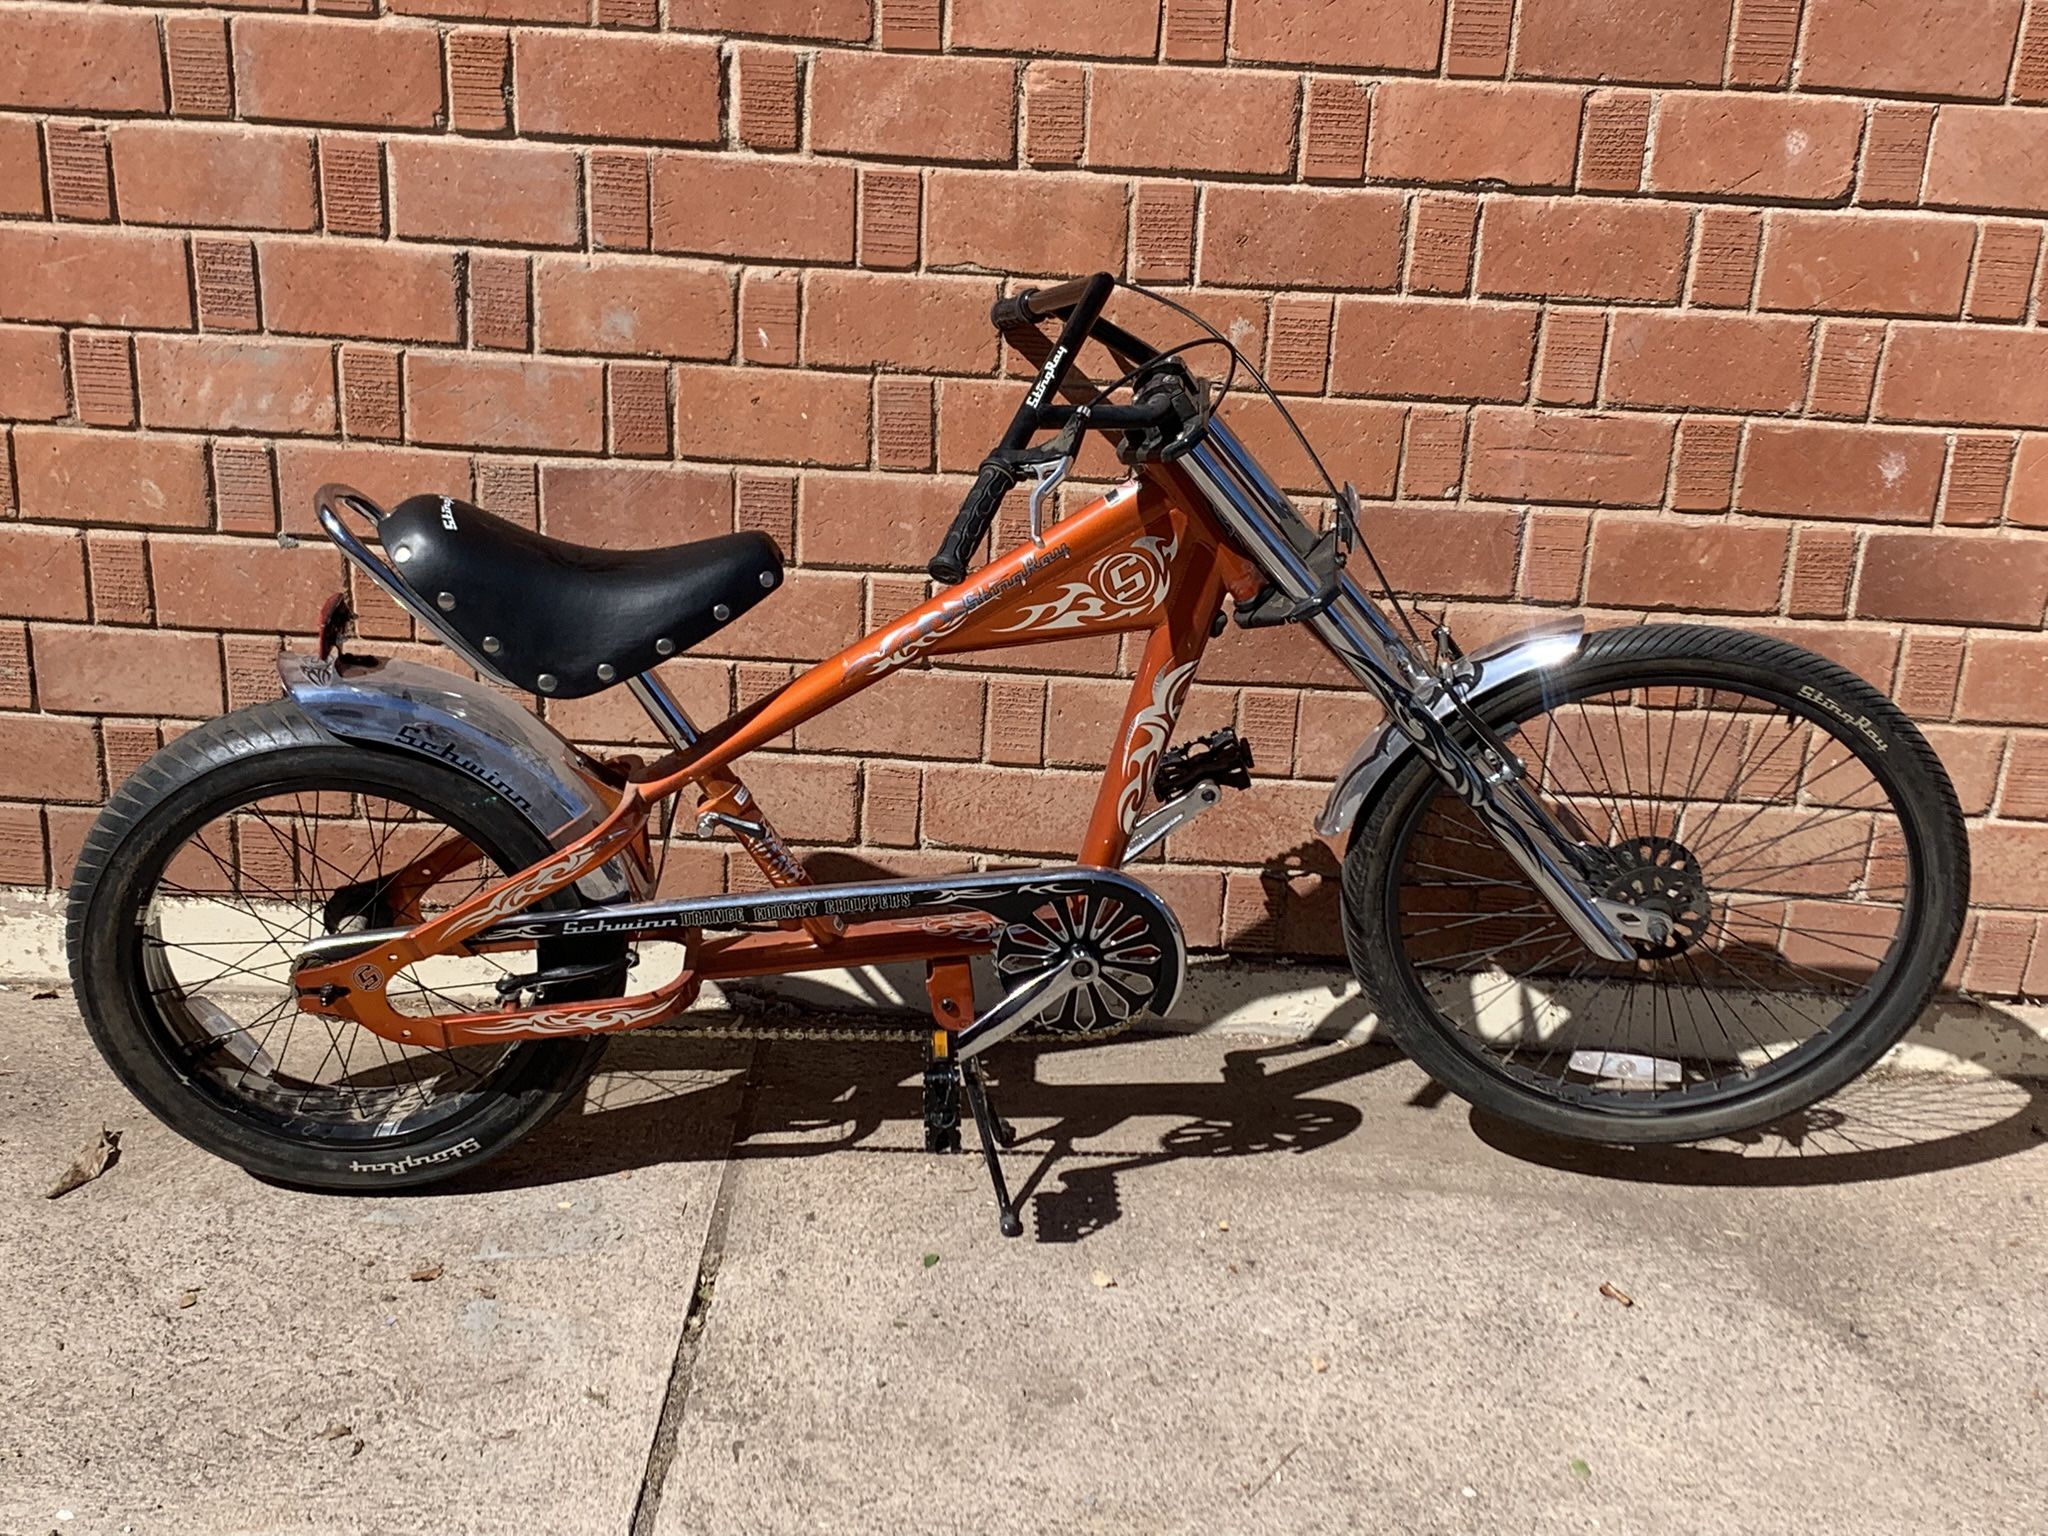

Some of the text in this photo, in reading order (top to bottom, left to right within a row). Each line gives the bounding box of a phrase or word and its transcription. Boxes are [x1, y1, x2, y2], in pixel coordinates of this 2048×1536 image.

[1109, 555, 1146, 602] S
[394, 725, 532, 814] Schwinn
[562, 893, 911, 935] Schwinn ORANGE COUNTY CHOPPERS
